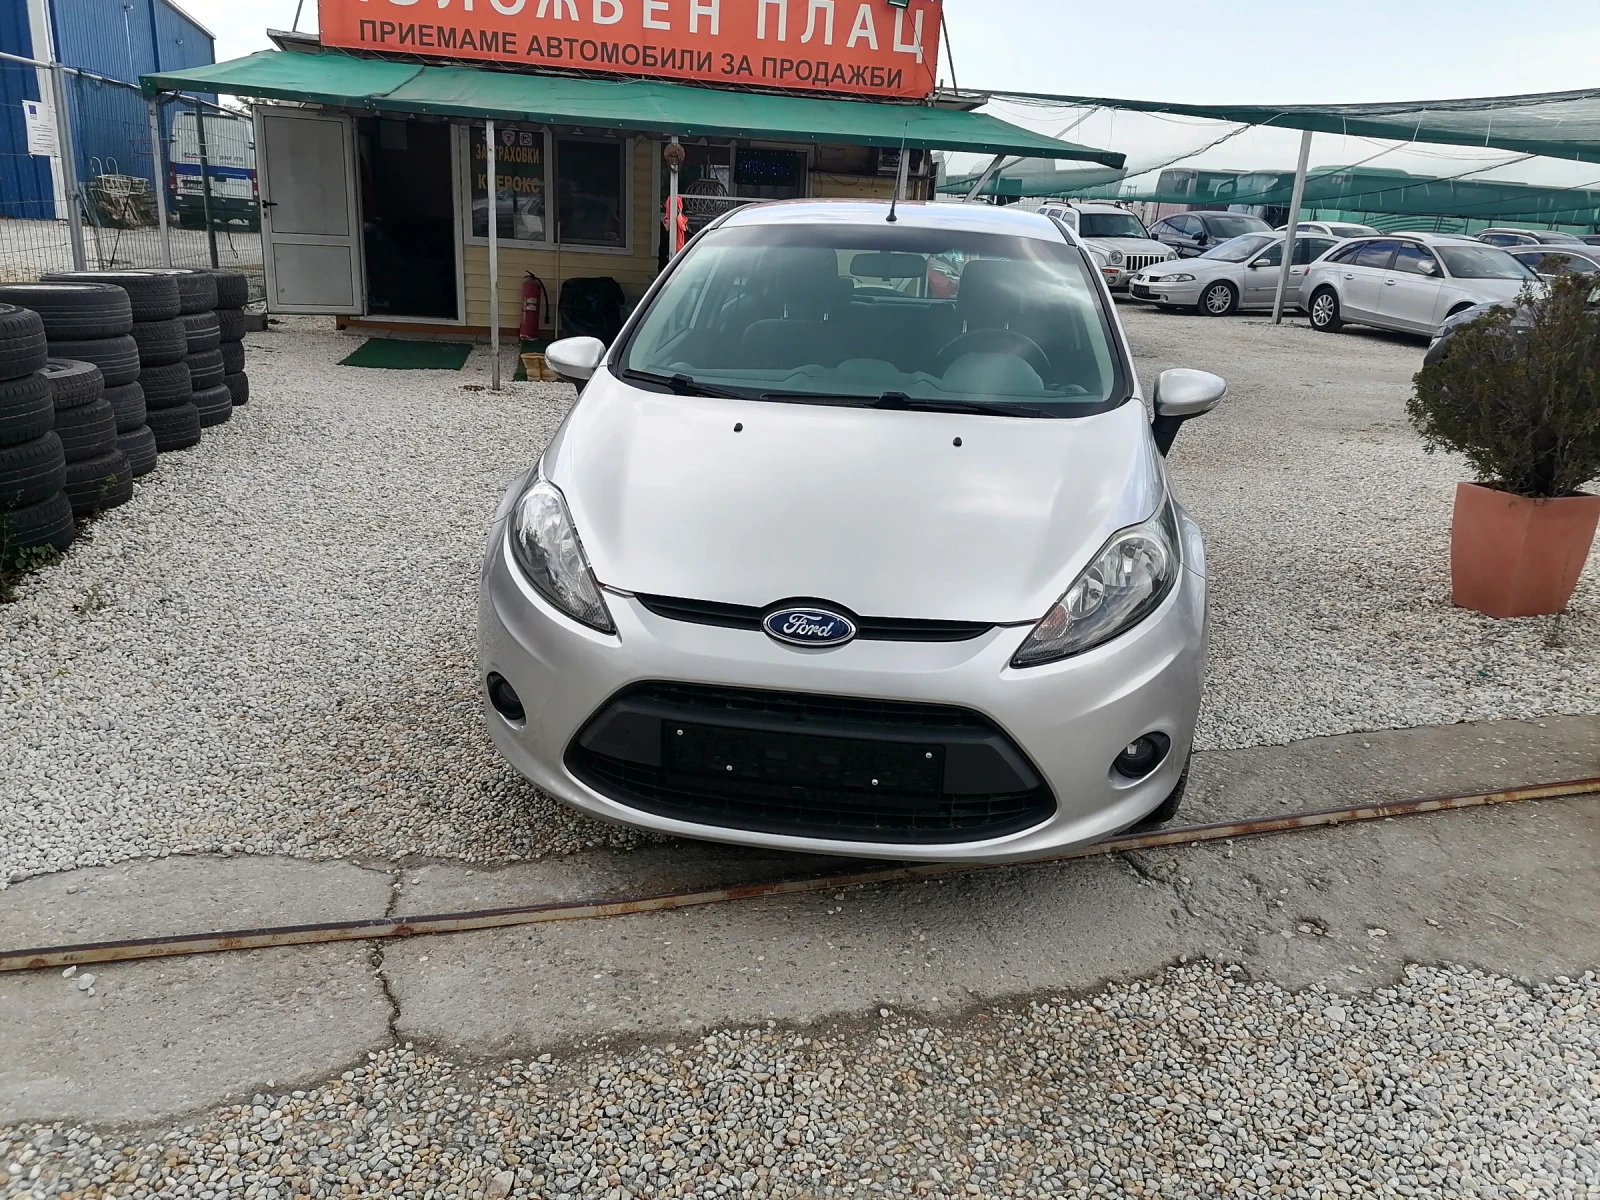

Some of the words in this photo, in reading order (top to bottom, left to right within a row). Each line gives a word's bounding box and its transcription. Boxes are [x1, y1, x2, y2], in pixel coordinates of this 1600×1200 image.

[756, 0, 924, 64] ПЛАЦ
[359, 19, 518, 55] ПРИЕМАМЕ
[526, 35, 713, 73] АВТОМОБИЛИ
[721, 53, 754, 77] ЗА
[761, 57, 903, 89] ПРОДАЖБИ
[475, 143, 540, 164] ЗАТРАХОВКИ
[478, 173, 540, 194] КЕРОКС
[783, 613, 835, 637] Ford
